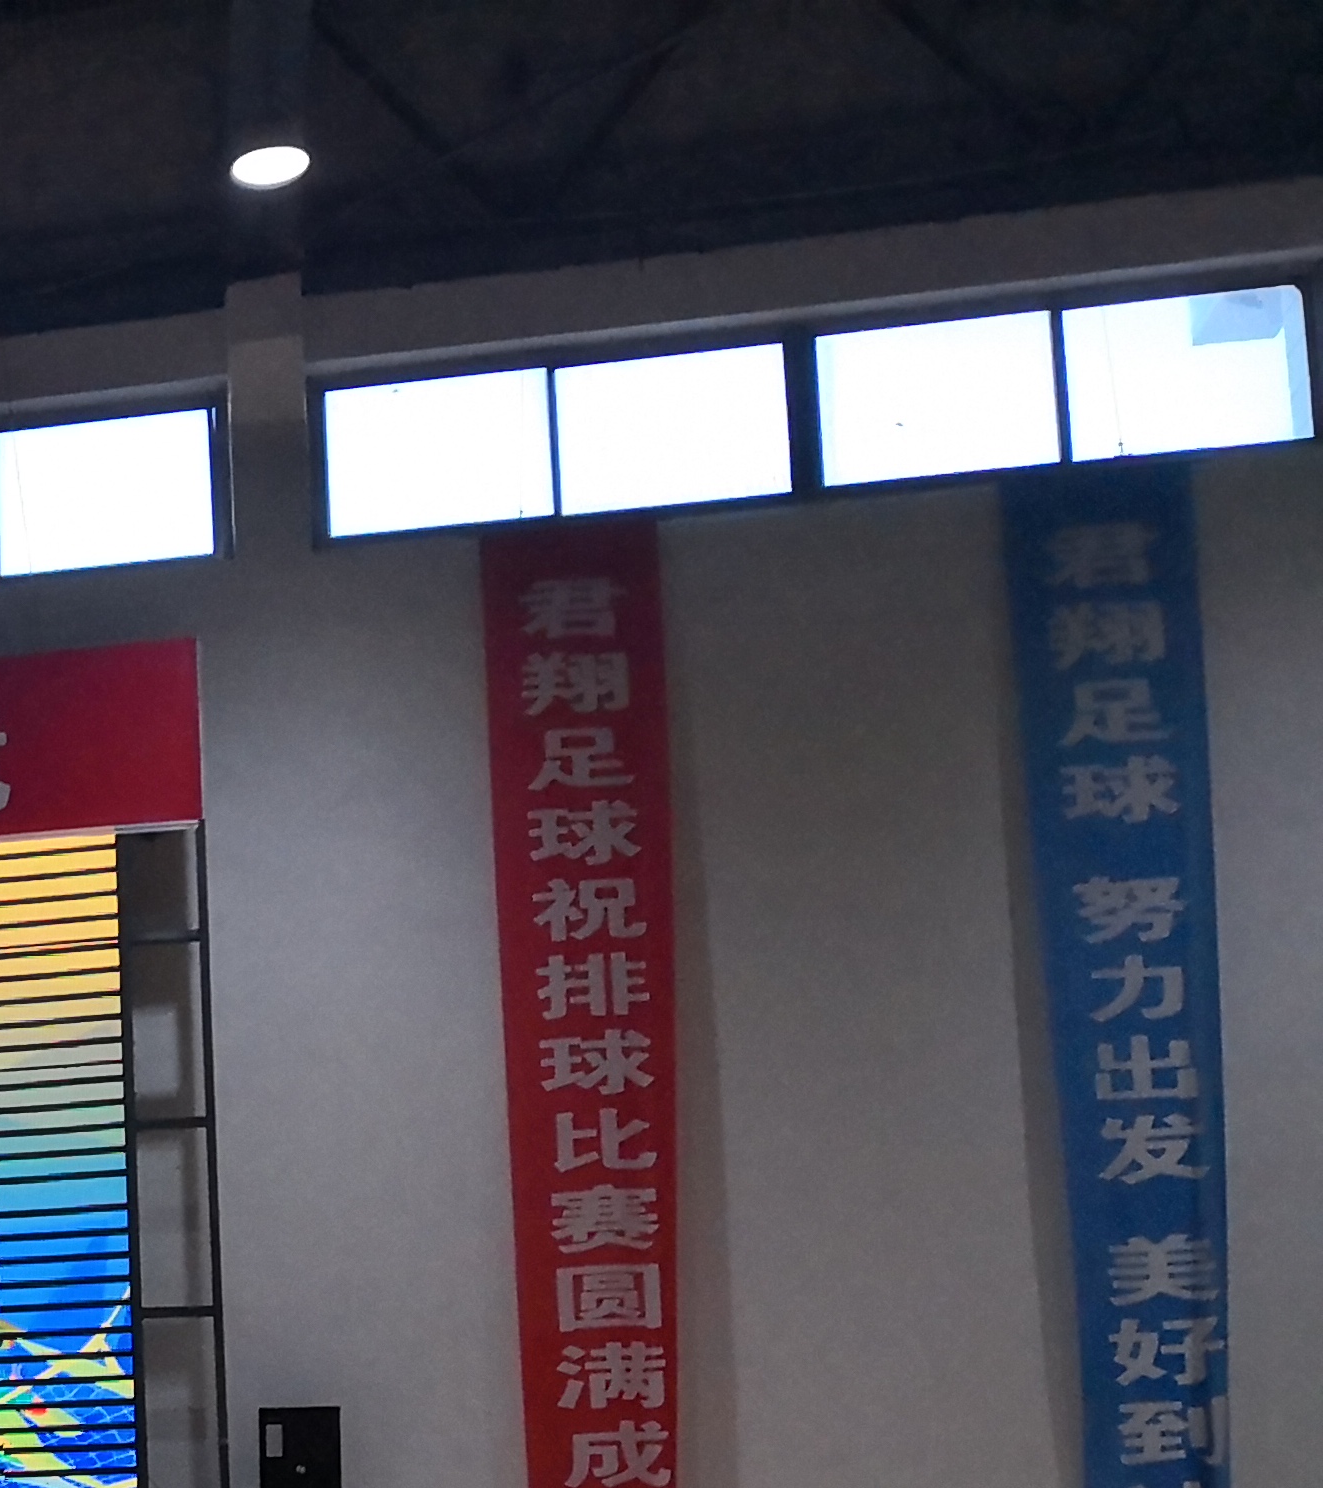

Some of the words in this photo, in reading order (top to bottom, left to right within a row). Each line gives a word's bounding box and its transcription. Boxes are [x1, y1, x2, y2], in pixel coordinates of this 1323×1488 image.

[1048, 523, 1179, 824] 君翔足球
[1072, 875, 1211, 1186] 努力出发
